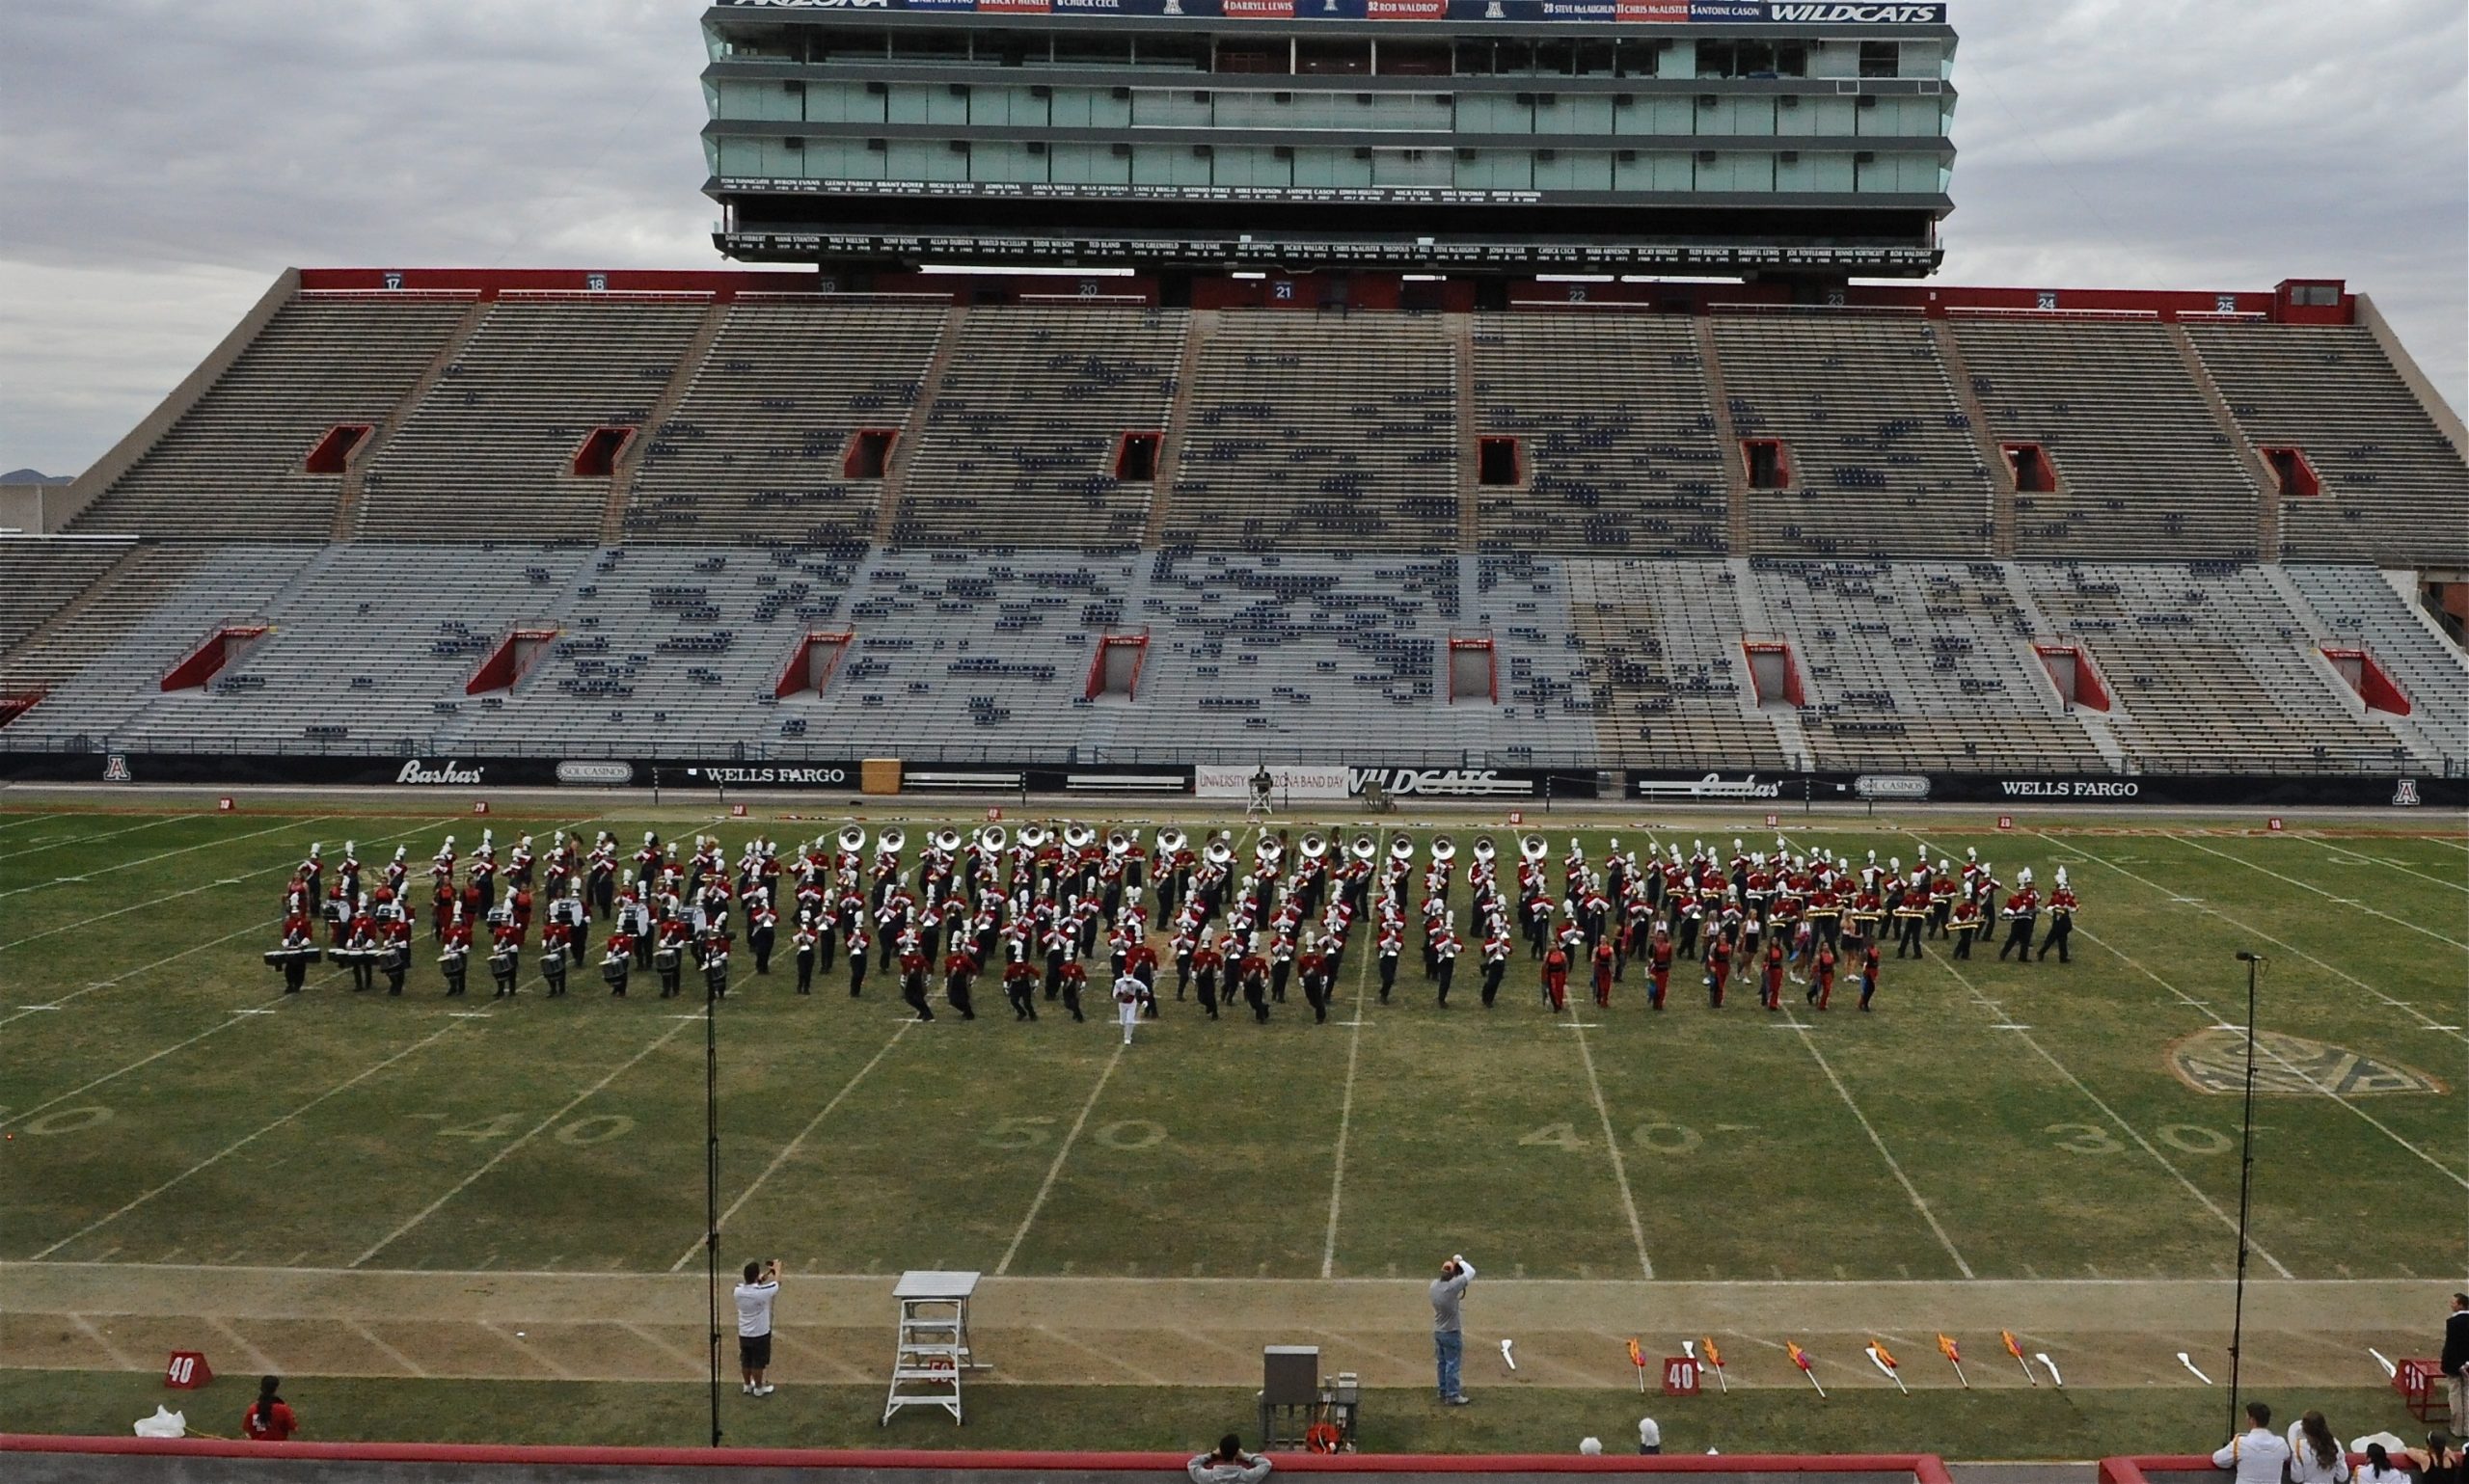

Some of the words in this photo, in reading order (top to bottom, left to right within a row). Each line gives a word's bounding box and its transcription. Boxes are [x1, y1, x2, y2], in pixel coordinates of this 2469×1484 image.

[1230, 1, 1266, 11] DARRYLL
[1268, 1, 1293, 11] LEWIS
[1368, 2, 1378, 12] 92
[1379, 3, 1397, 12] ROB
[1398, 3, 1439, 13] WALDROP
[1555, 4, 1574, 13] STEVE
[1574, 4, 1615, 13] McLAUGHLIN
[1624, 4, 1647, 13] CHRIS
[1648, 5, 1688, 14] McALISTER
[1696, 6, 1731, 14] ANTOINE
[1732, 7, 1759, 15] CASON
[1771, 5, 1937, 22] WILDCATS
[386, 278, 401, 289] 17
[589, 279, 605, 290] 18
[822, 282, 835, 293] 19
[1080, 284, 1098, 295] 20
[1276, 286, 1290, 298] 21
[1569, 291, 1585, 302] 22
[2038, 298, 2054, 309] 24
[2217, 301, 2234, 312] 25
[396, 760, 485, 783] Bashas'
[705, 769, 774, 782] WELLS
[779, 769, 845, 782] FARGO
[1199, 775, 1246, 788] UNIVERSITY
[1300, 775, 1326, 788] BAND
[1327, 776, 1344, 788] DAY
[2001, 781, 2070, 796] WELLS
[2073, 782, 2138, 796] FARGO
[978, 1116, 1171, 1150] 50
[169, 1357, 194, 1384] 40
[1669, 1363, 1694, 1390] 40
